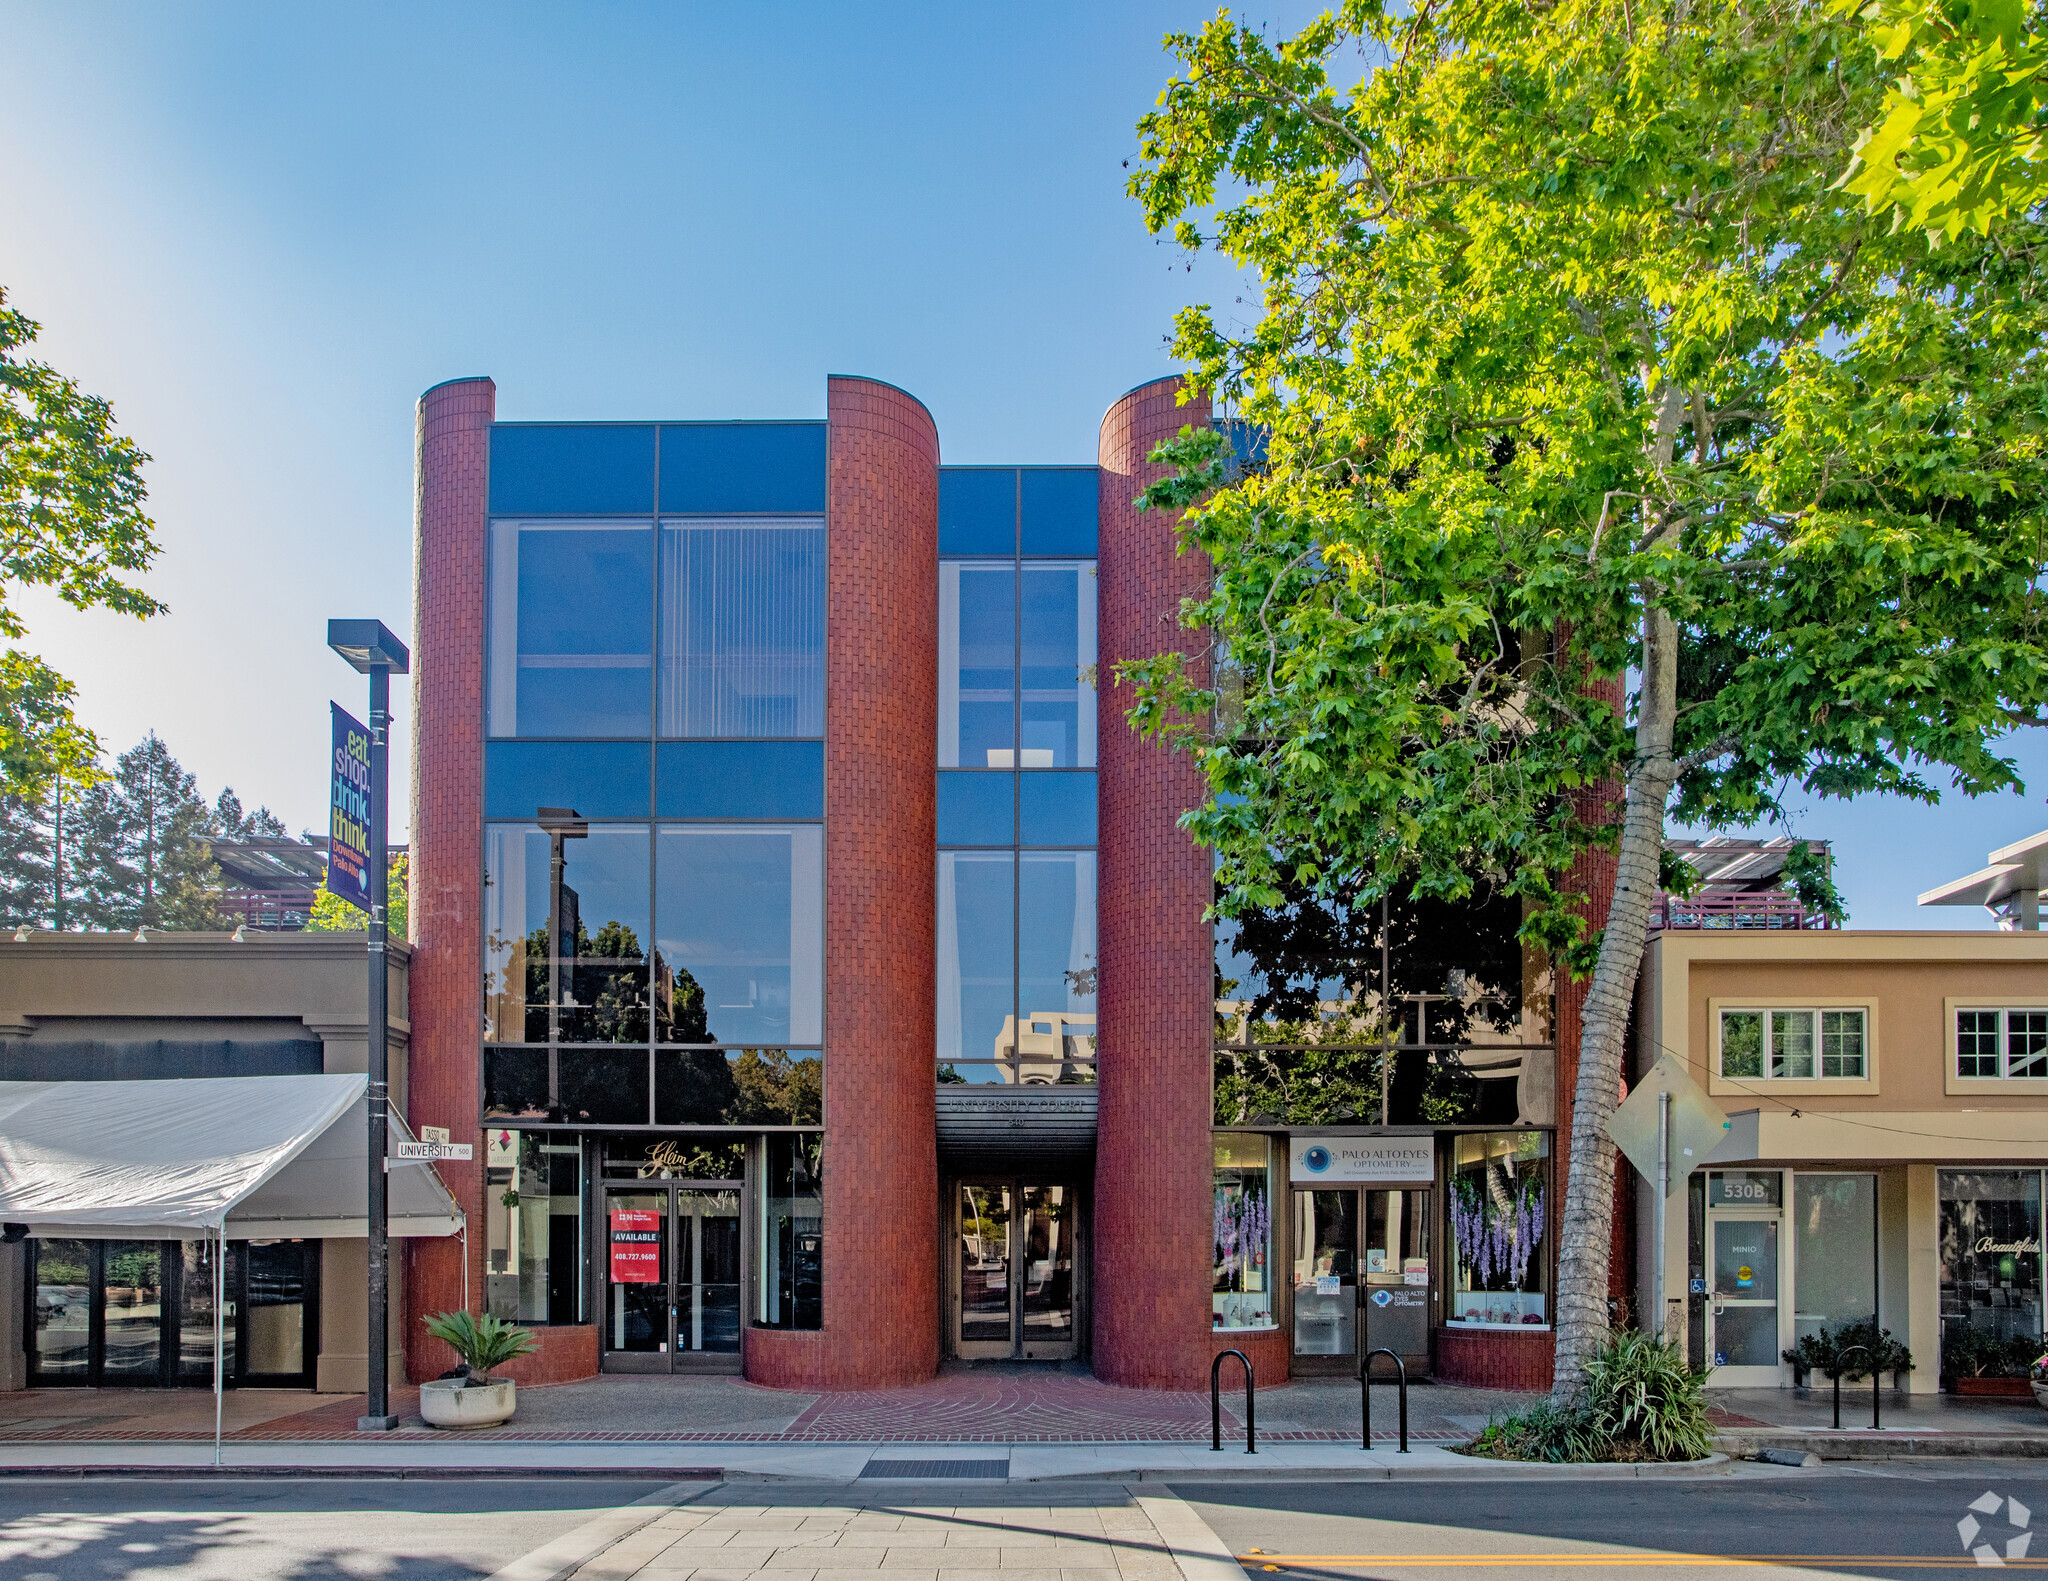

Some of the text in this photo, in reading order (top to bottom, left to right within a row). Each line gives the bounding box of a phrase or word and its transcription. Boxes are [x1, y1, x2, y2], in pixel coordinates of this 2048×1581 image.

[347, 729, 370, 768] eat.
[335, 745, 370, 793] shop.
[334, 775, 370, 826] drink.
[333, 806, 370, 858] think.
[333, 838, 364, 867] Downtown
[333, 854, 359, 878] Palo Alto
[949, 1099, 1086, 1112] UNIVERSITY COURT
[1008, 1118, 1024, 1126] 540
[426, 1128, 440, 1141] TASSO
[400, 1144, 454, 1157] UNIVERSITY
[1342, 1150, 1429, 1159] PALO ALTO EYES
[640, 1140, 704, 1178] Gleim
[1353, 1160, 1411, 1168] OPTOMETRY
[1724, 1184, 1765, 1198] 530B
[615, 1233, 656, 1241] AVAILABLE
[615, 1253, 656, 1261] 408.727.9600
